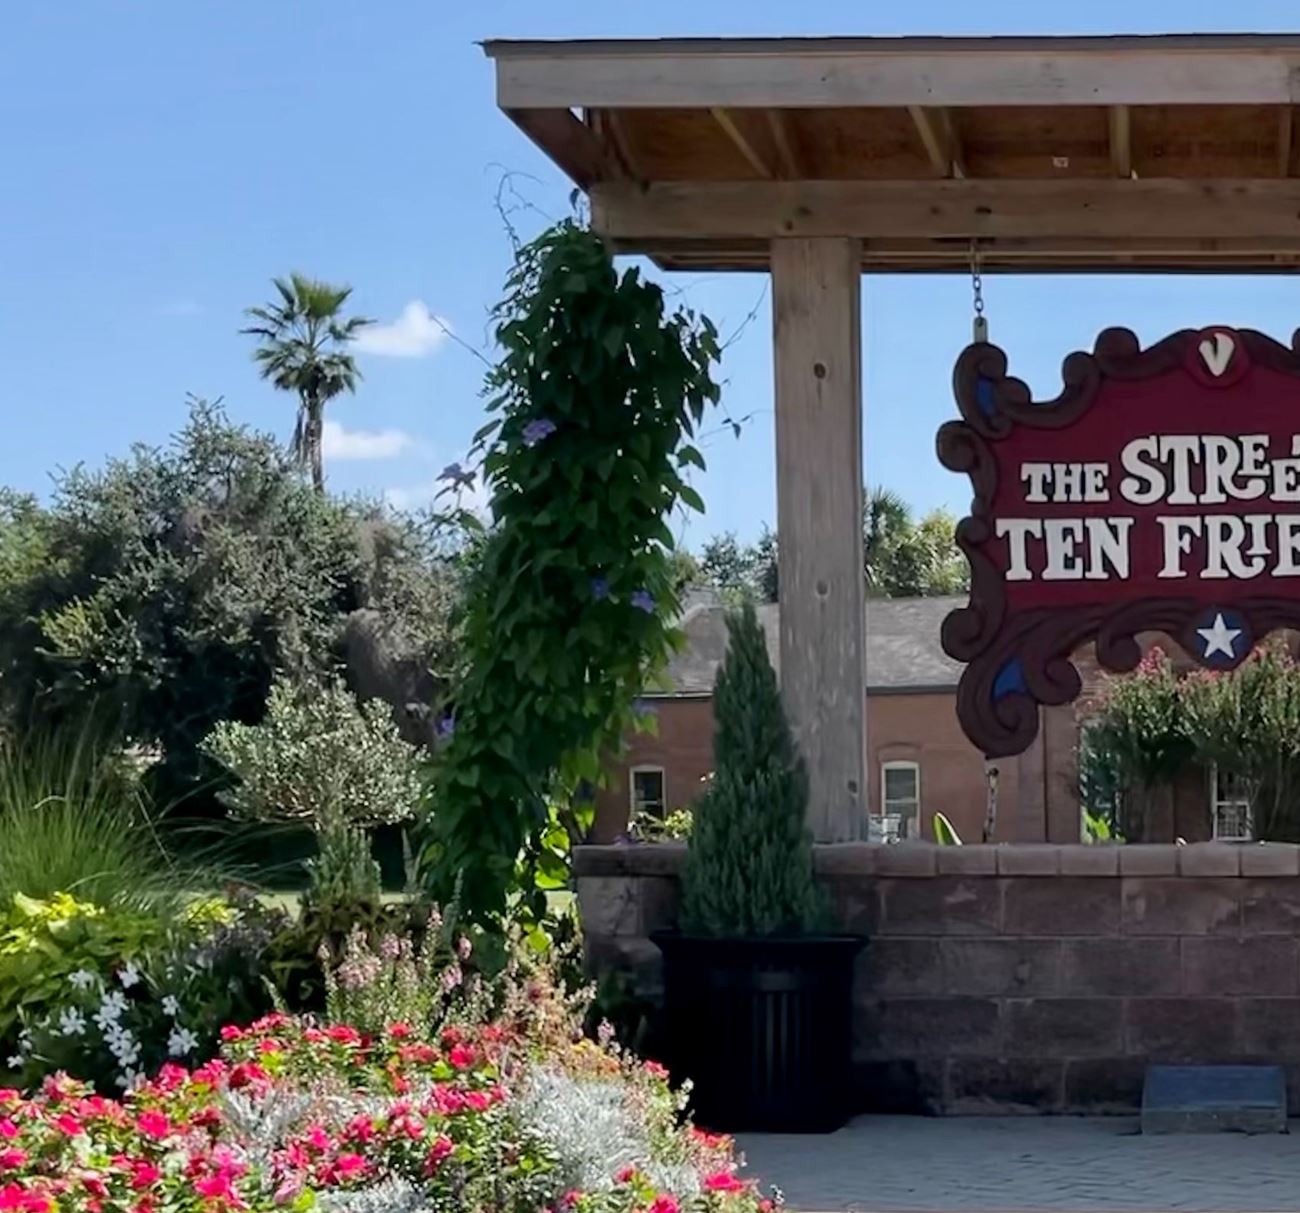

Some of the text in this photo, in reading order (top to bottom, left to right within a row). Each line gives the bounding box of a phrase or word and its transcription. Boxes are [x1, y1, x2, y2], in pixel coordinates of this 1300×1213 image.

[1199, 332, 1235, 377] V
[1020, 463, 1109, 503] THE
[995, 517, 1134, 581] TEN
